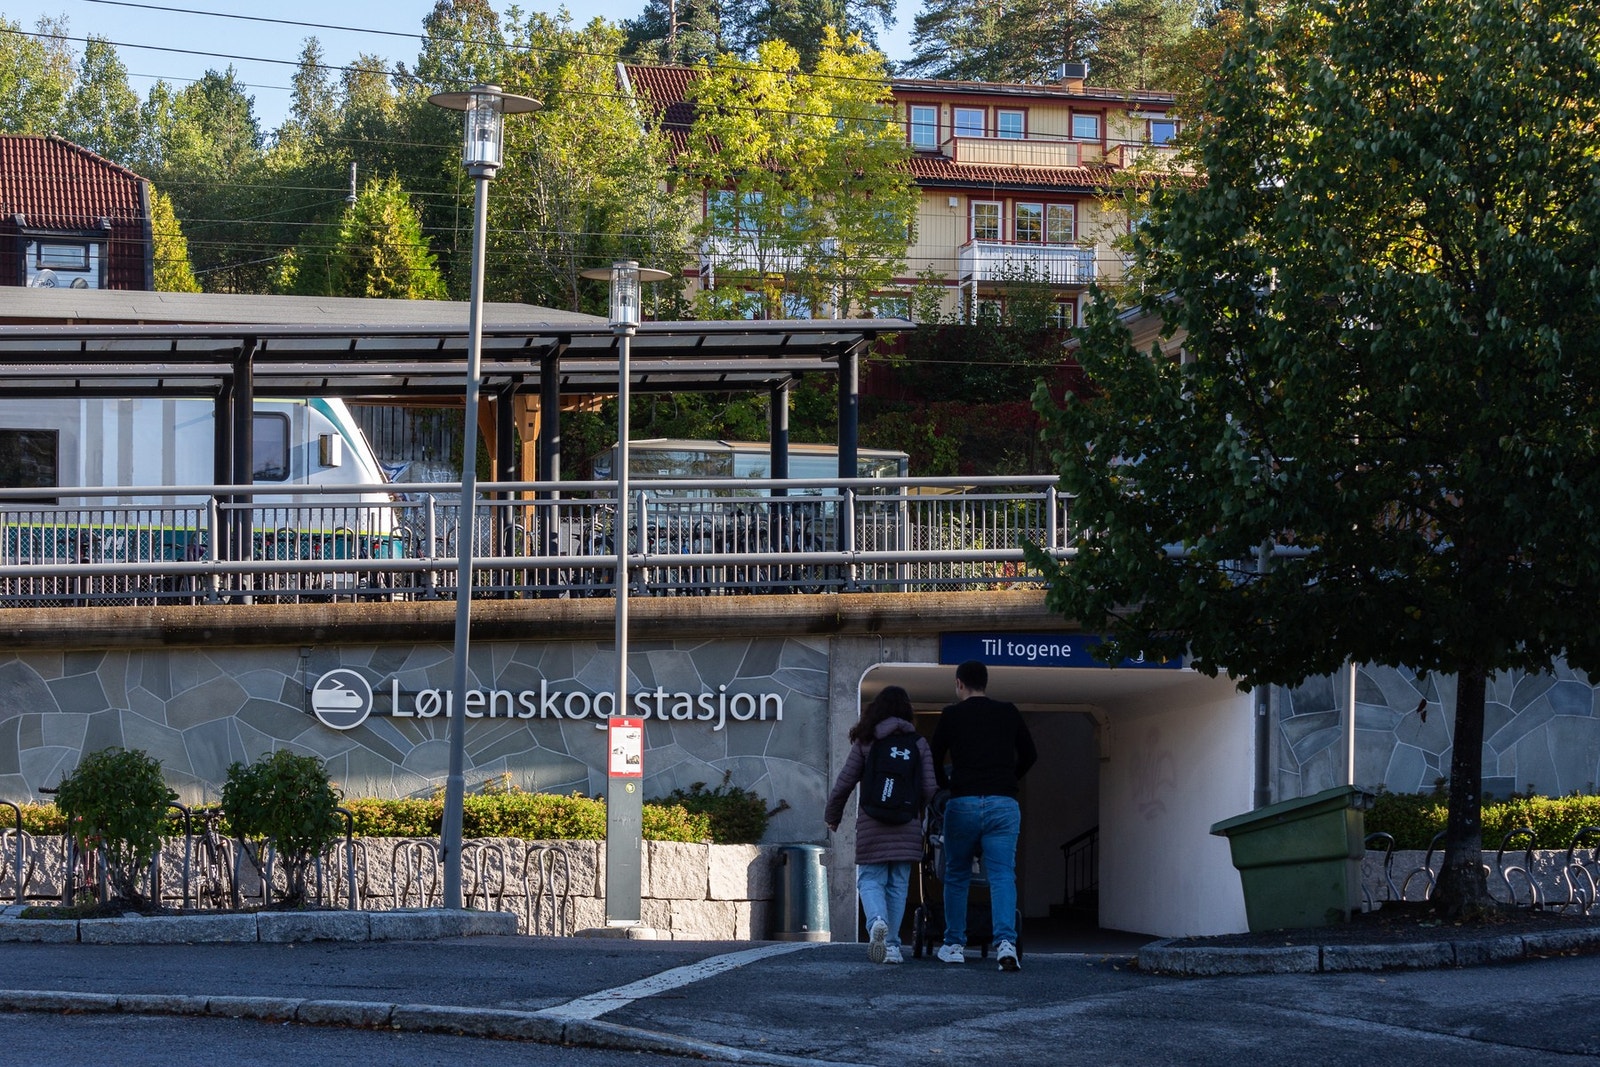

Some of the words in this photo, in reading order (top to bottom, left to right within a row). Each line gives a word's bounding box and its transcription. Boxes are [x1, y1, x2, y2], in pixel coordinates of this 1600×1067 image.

[981, 638, 1002, 656] Til
[1007, 640, 1072, 660] togene
[634, 684, 784, 731] stasjon
